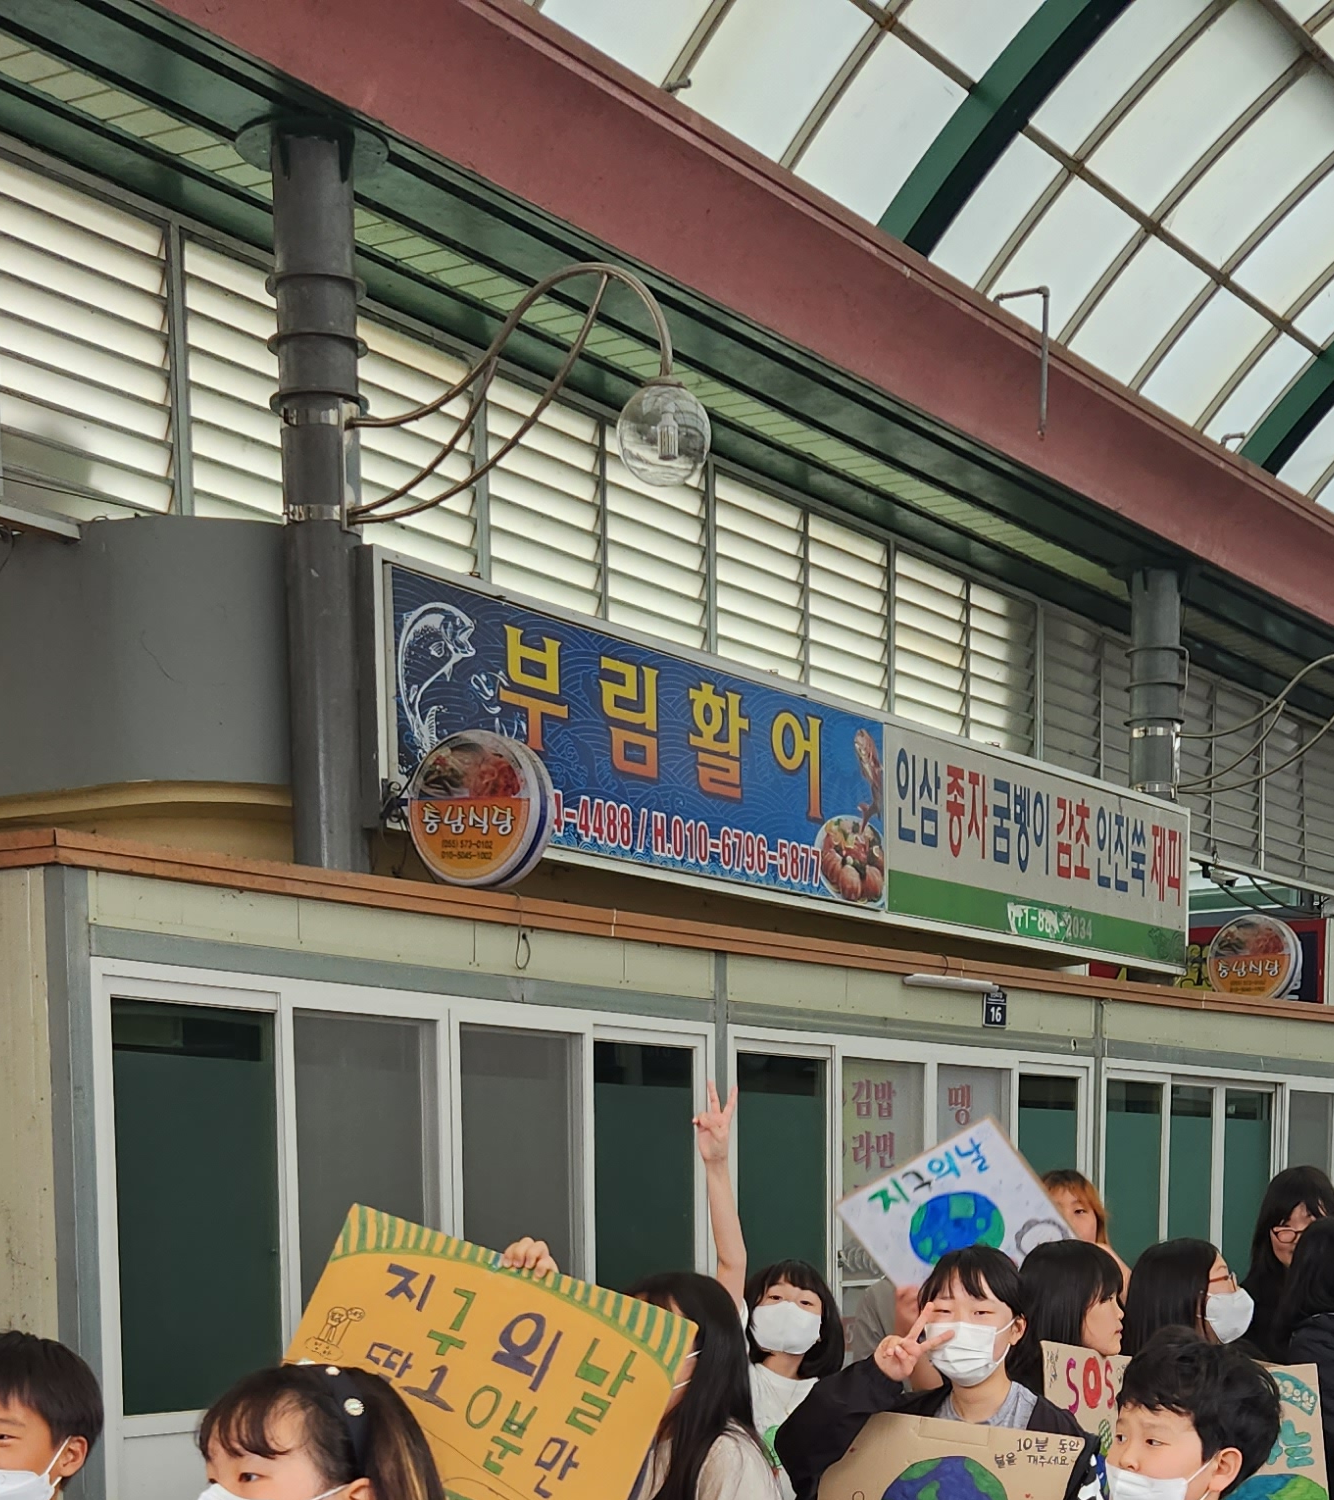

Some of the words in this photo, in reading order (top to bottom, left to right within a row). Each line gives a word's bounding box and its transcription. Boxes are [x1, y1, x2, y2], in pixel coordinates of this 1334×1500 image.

[497, 624, 824, 822] 부림활어
[895, 747, 941, 848] 인삼
[946, 763, 987, 860] 종자
[992, 777, 1050, 876] 굼벵이
[1056, 797, 1091, 880] 감초
[1096, 805, 1147, 897] 인진쑥
[1150, 824, 1181, 906] 제피
[653, 821, 822, 886] H.010-6796-5877
[990, 1006, 1002, 1023] 16
[852, 1078, 896, 1120] 김밥
[852, 1130, 895, 1170] 라면
[1065, 1355, 1116, 1415] SOS
[1016, 1437, 1049, 1453] 10분
[1058, 1438, 1080, 1454] 동안
